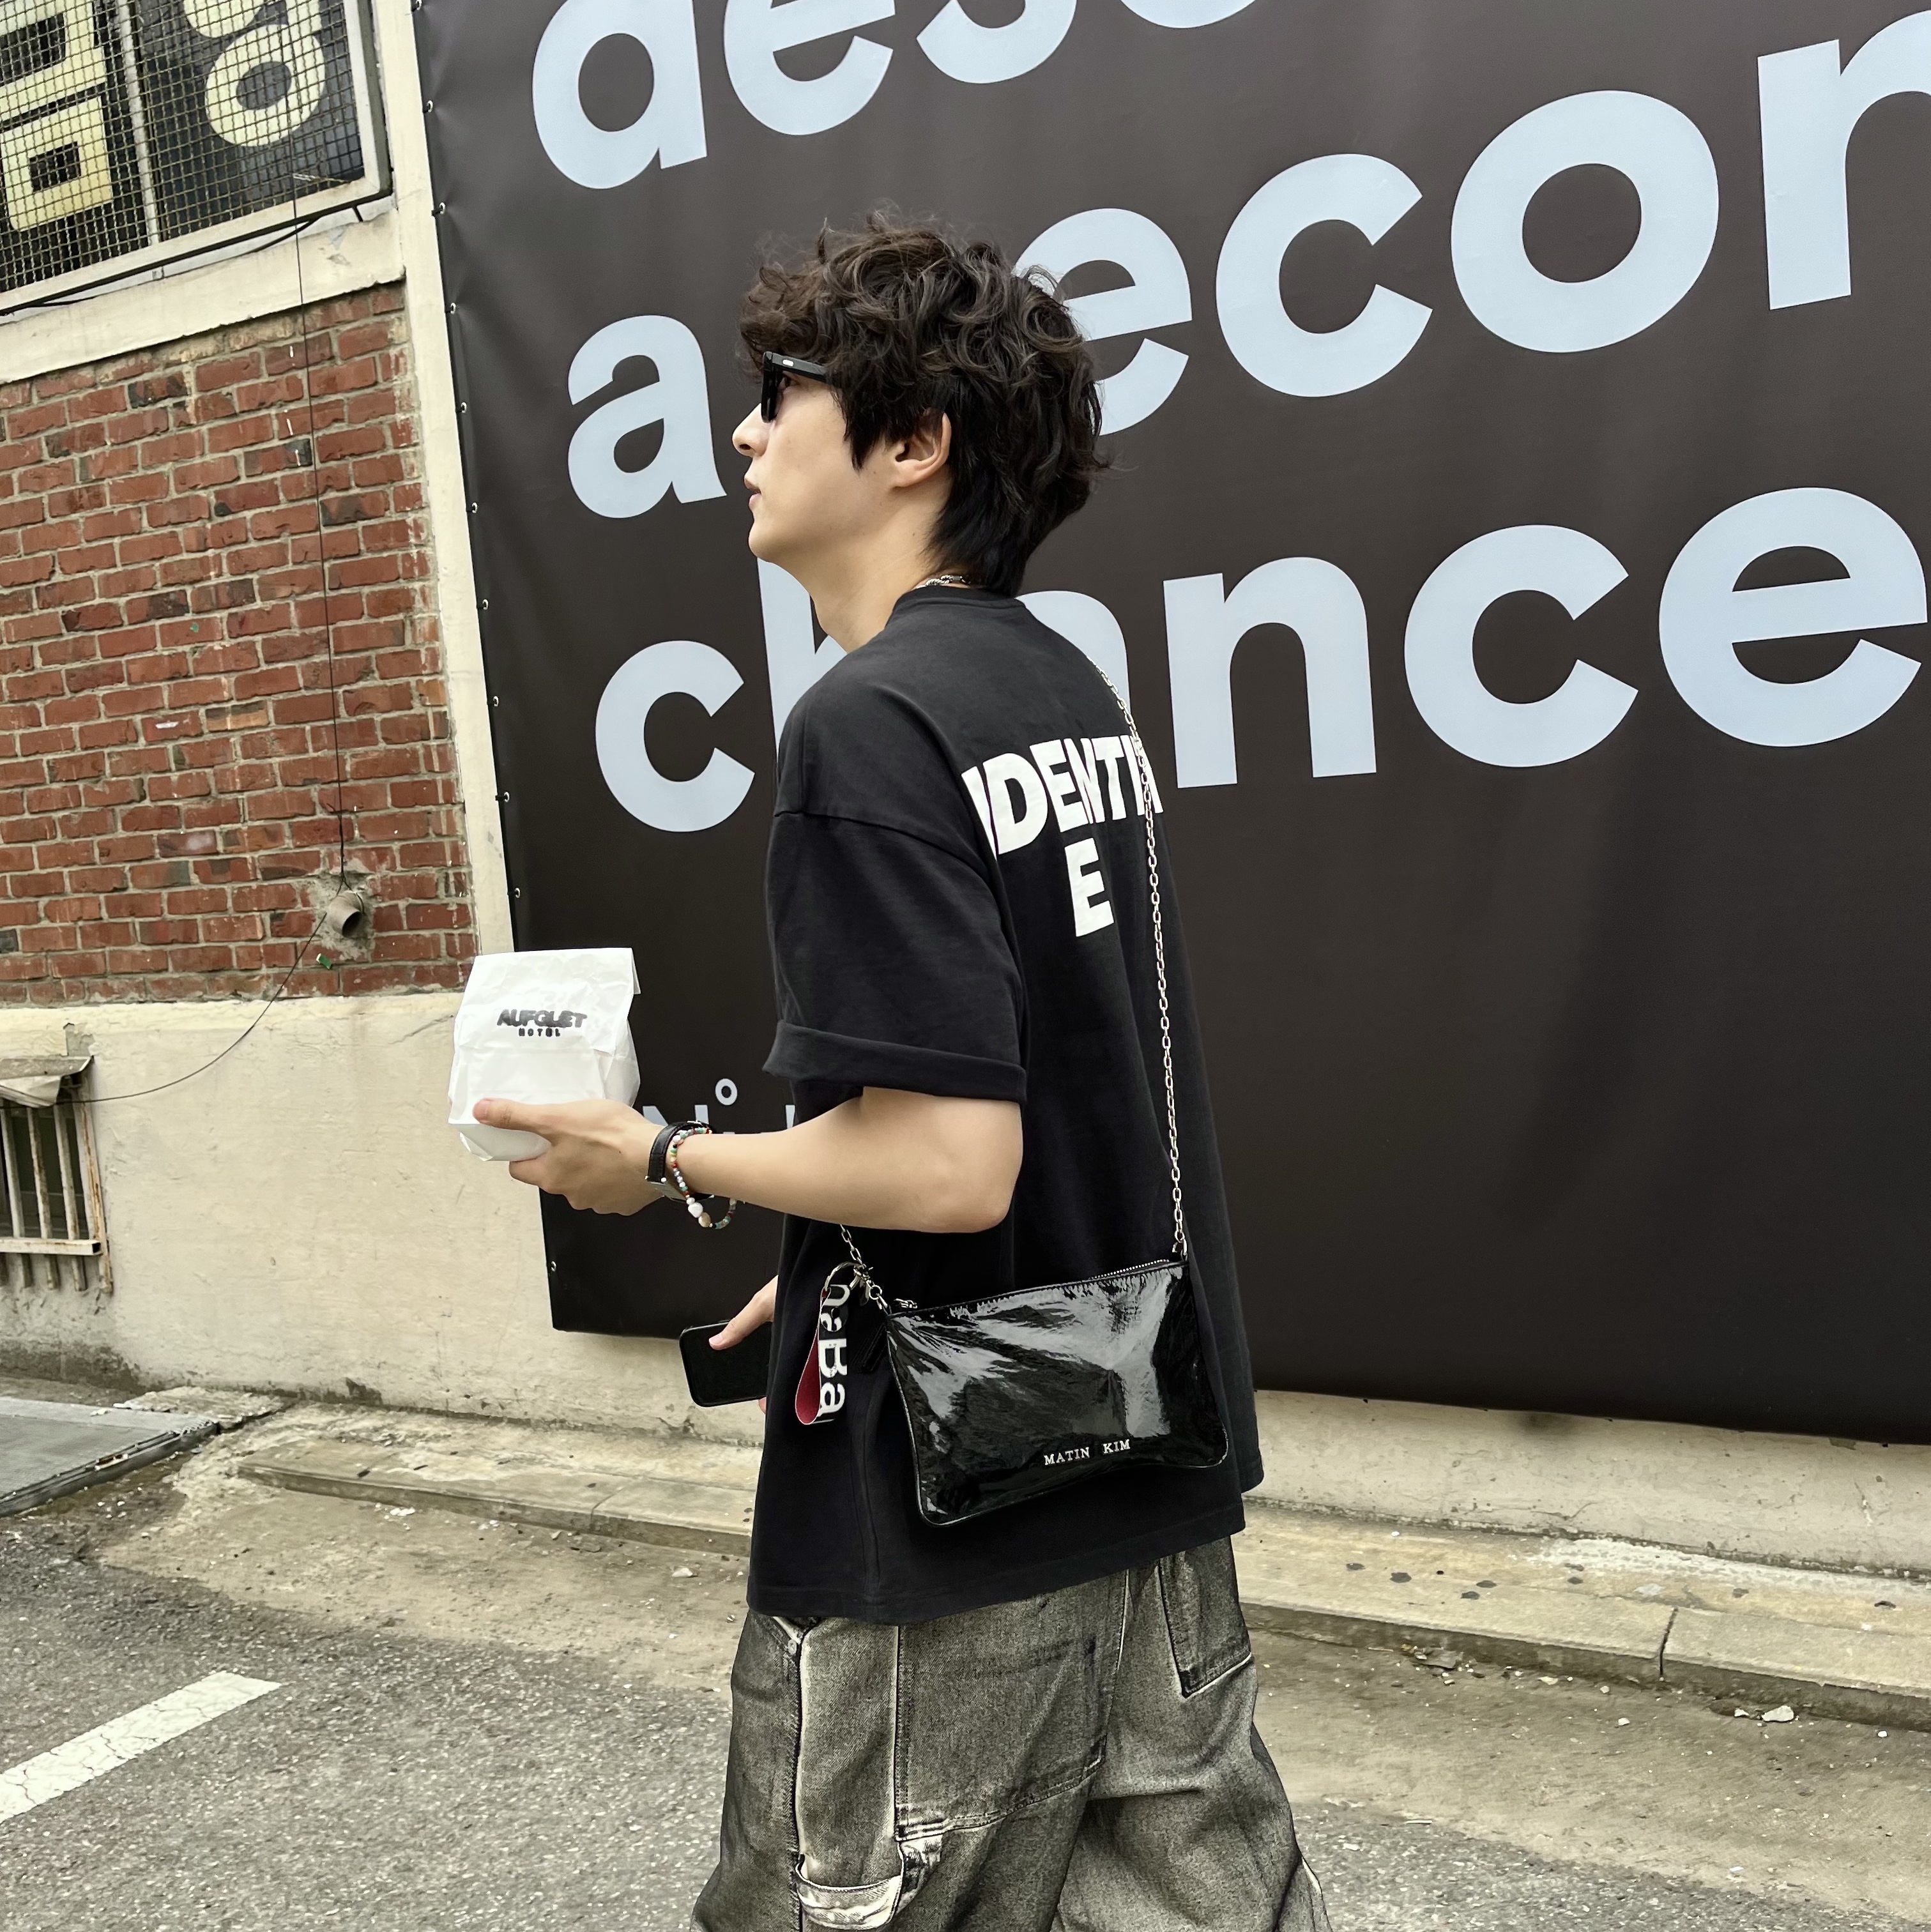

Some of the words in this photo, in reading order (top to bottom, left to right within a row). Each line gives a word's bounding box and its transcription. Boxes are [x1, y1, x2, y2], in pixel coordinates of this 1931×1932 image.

[568, 314, 727, 519] a
[1064, 838, 1115, 938] E
[1044, 1447, 1090, 1466] MATIN
[1103, 1439, 1131, 1454] KIM
